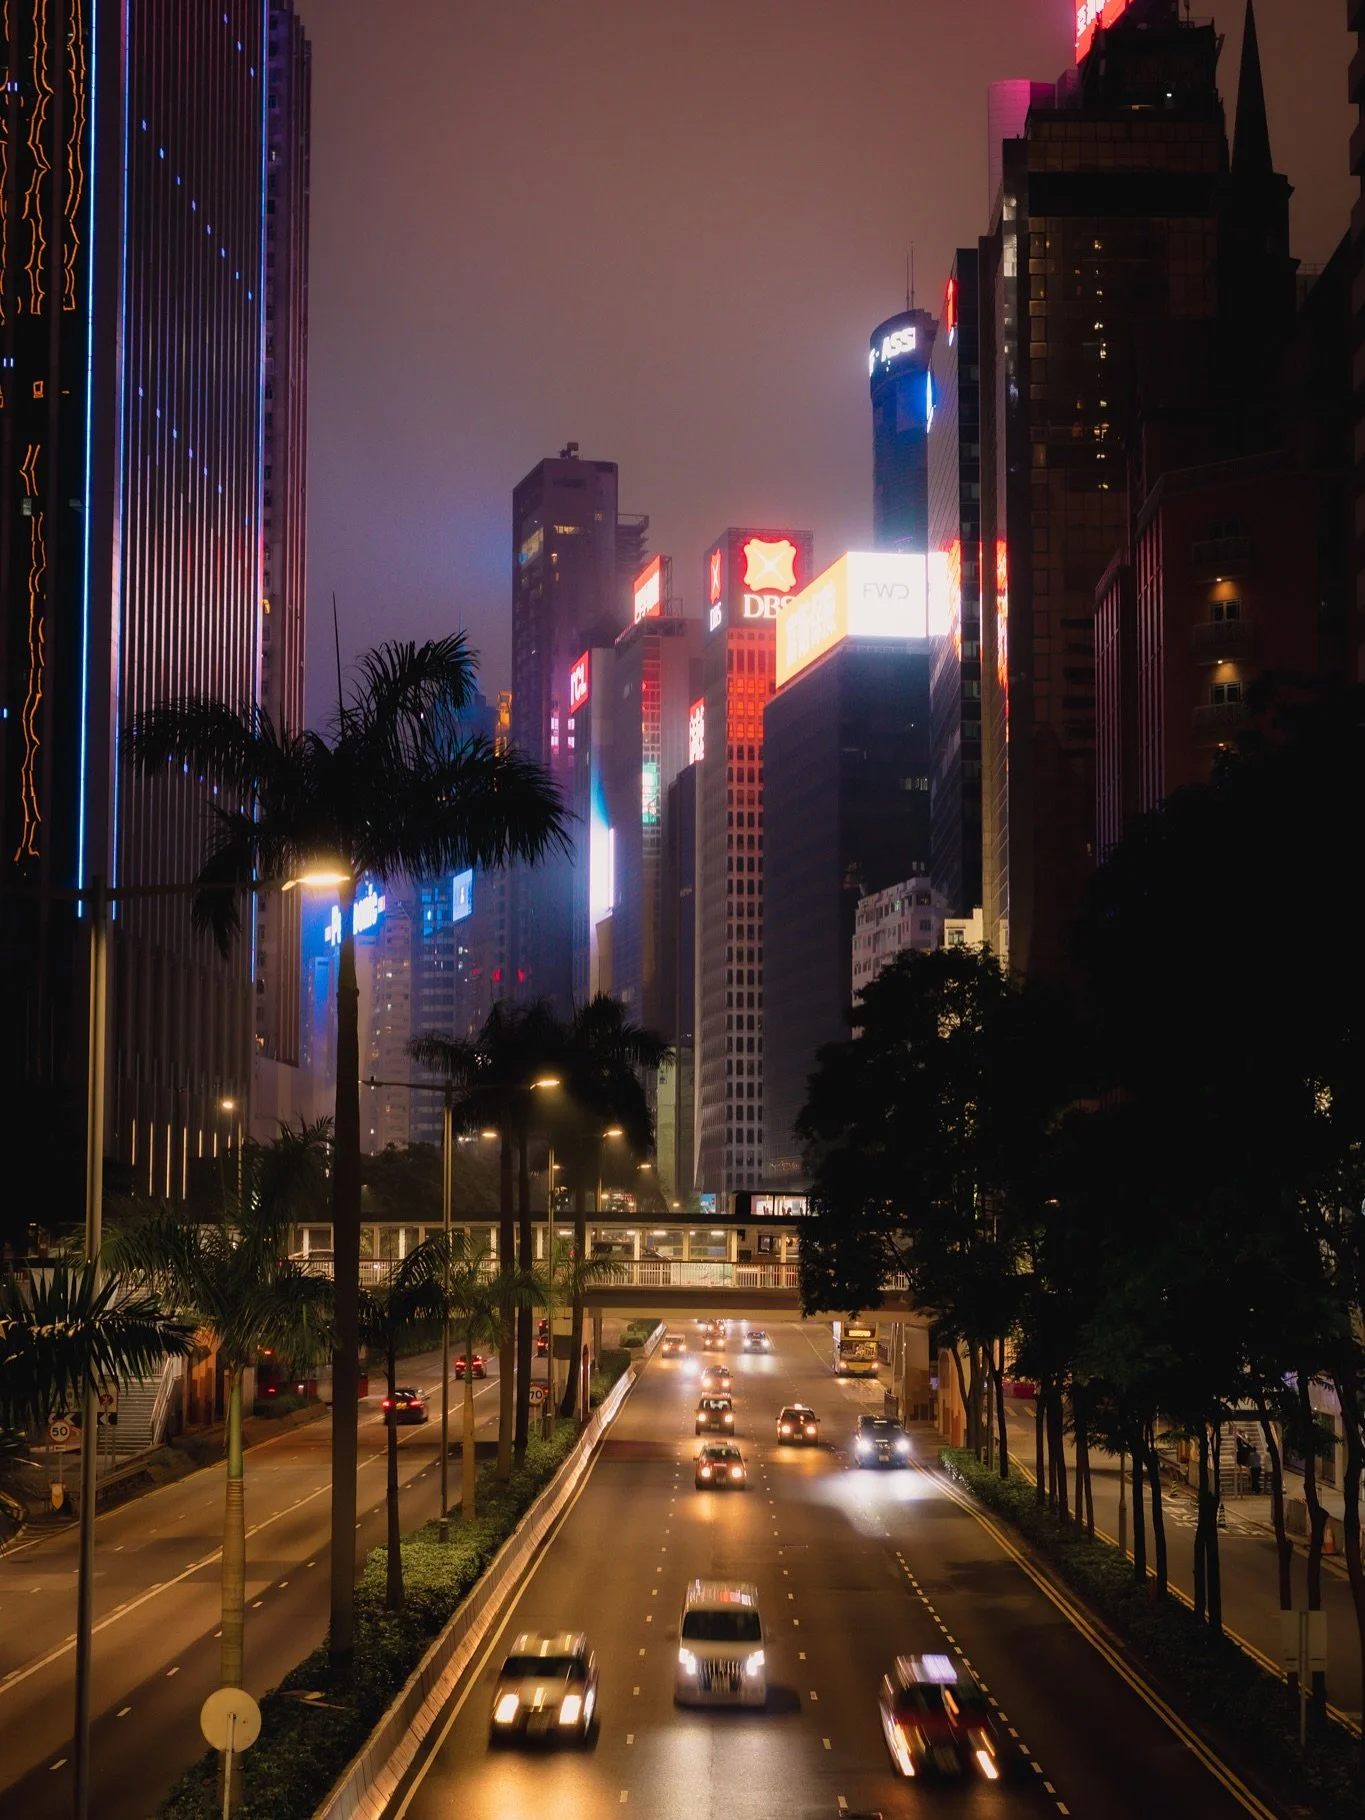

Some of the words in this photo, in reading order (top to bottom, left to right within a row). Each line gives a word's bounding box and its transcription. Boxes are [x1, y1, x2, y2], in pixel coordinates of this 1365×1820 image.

[862, 582, 910, 600] FWD
[570, 663, 587, 706] TCL
[529, 1390, 543, 1400] 70
[52, 1426, 68, 1437] 50
